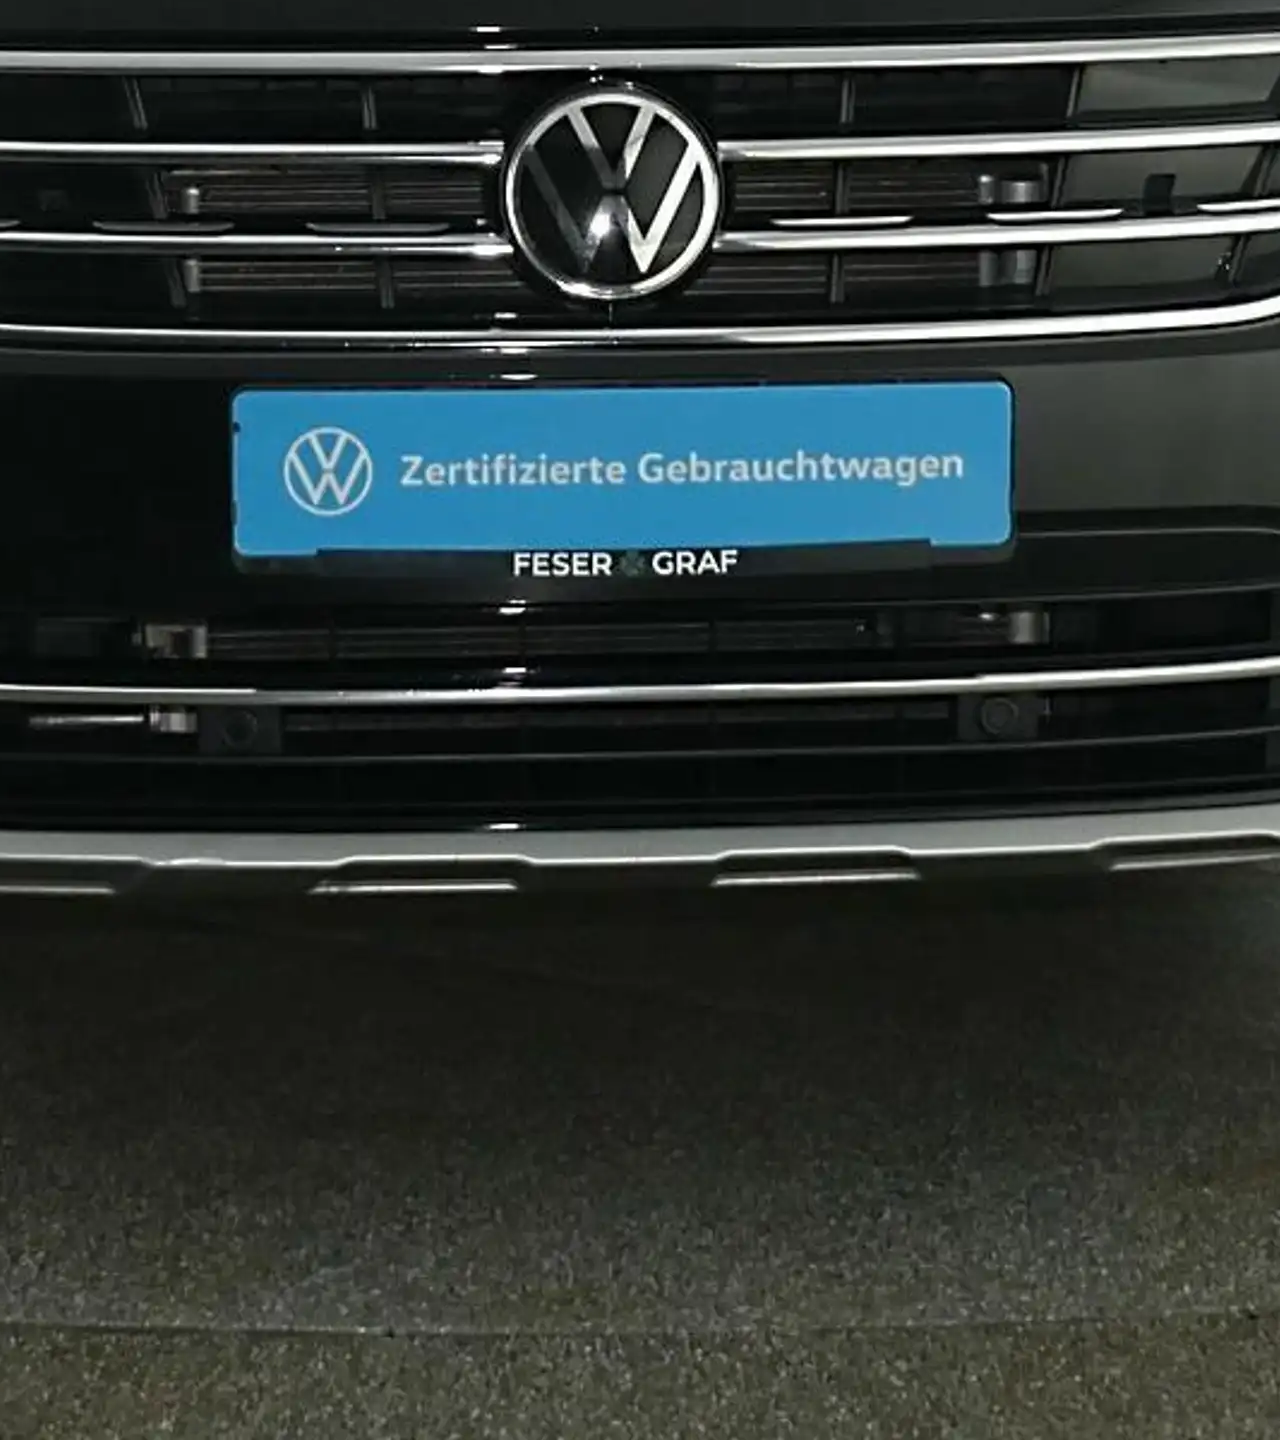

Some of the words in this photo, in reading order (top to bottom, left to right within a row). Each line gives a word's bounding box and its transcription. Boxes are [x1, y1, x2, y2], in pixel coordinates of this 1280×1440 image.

[401, 455, 627, 486] Zertifizierte
[638, 450, 964, 487] Gebrauchtwagen
[513, 552, 613, 577] FESER
[652, 549, 738, 575] GRAF
